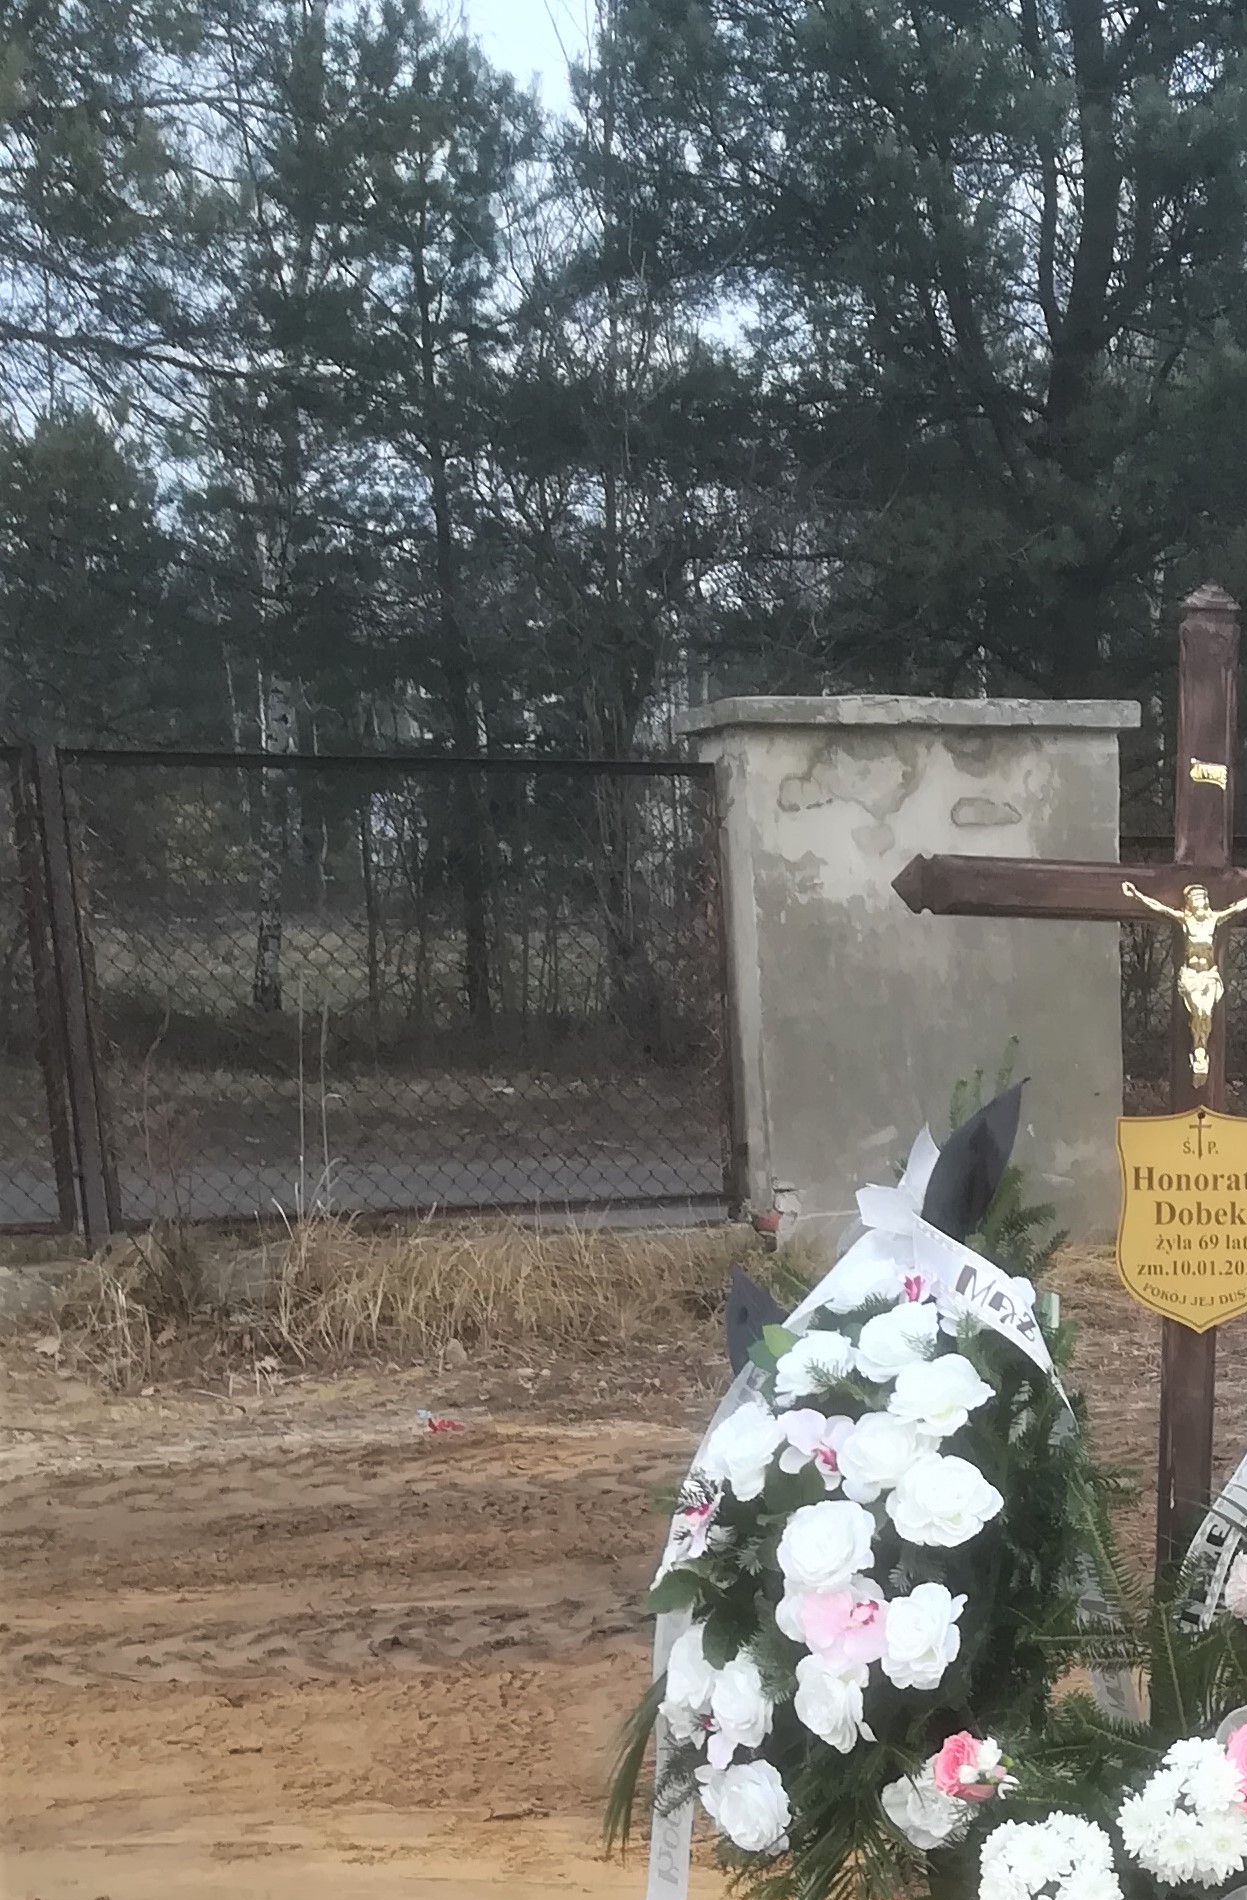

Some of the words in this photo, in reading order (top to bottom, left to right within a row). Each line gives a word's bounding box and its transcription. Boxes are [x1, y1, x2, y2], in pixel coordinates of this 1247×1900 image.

[1183, 1137, 1195, 1154] Ś.
[1208, 1141, 1219, 1155] P.
[1153, 1201, 1247, 1226] Dobek
[1198, 1234, 1219, 1250] 69
[1225, 1234, 1247, 1250] lat
[1143, 1282, 1187, 1305] POKÓJ
[1190, 1296, 1215, 1307] JEJ
